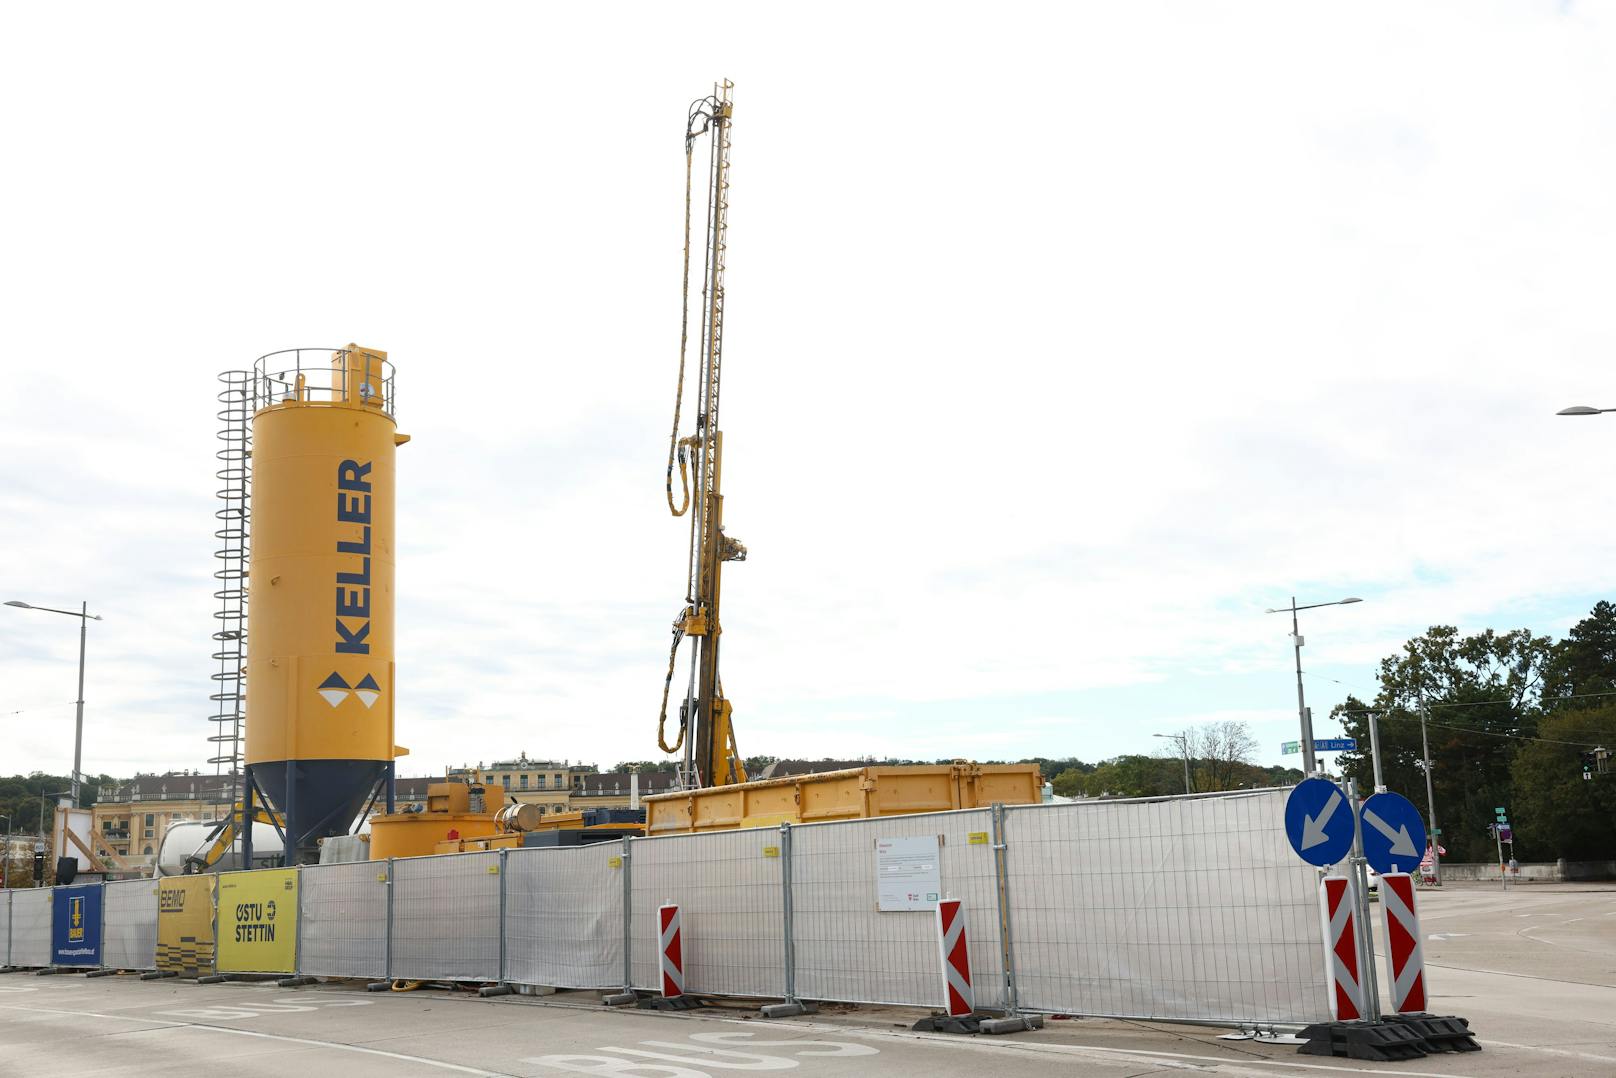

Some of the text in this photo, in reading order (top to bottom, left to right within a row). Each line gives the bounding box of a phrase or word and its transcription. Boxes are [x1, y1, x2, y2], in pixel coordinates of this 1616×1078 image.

[335, 459, 372, 655] KELLER
[160, 889, 185, 908] BEMO
[235, 924, 275, 943] STETTIN
[152, 997, 374, 1021] BUS
[519, 1032, 881, 1078] BUS
